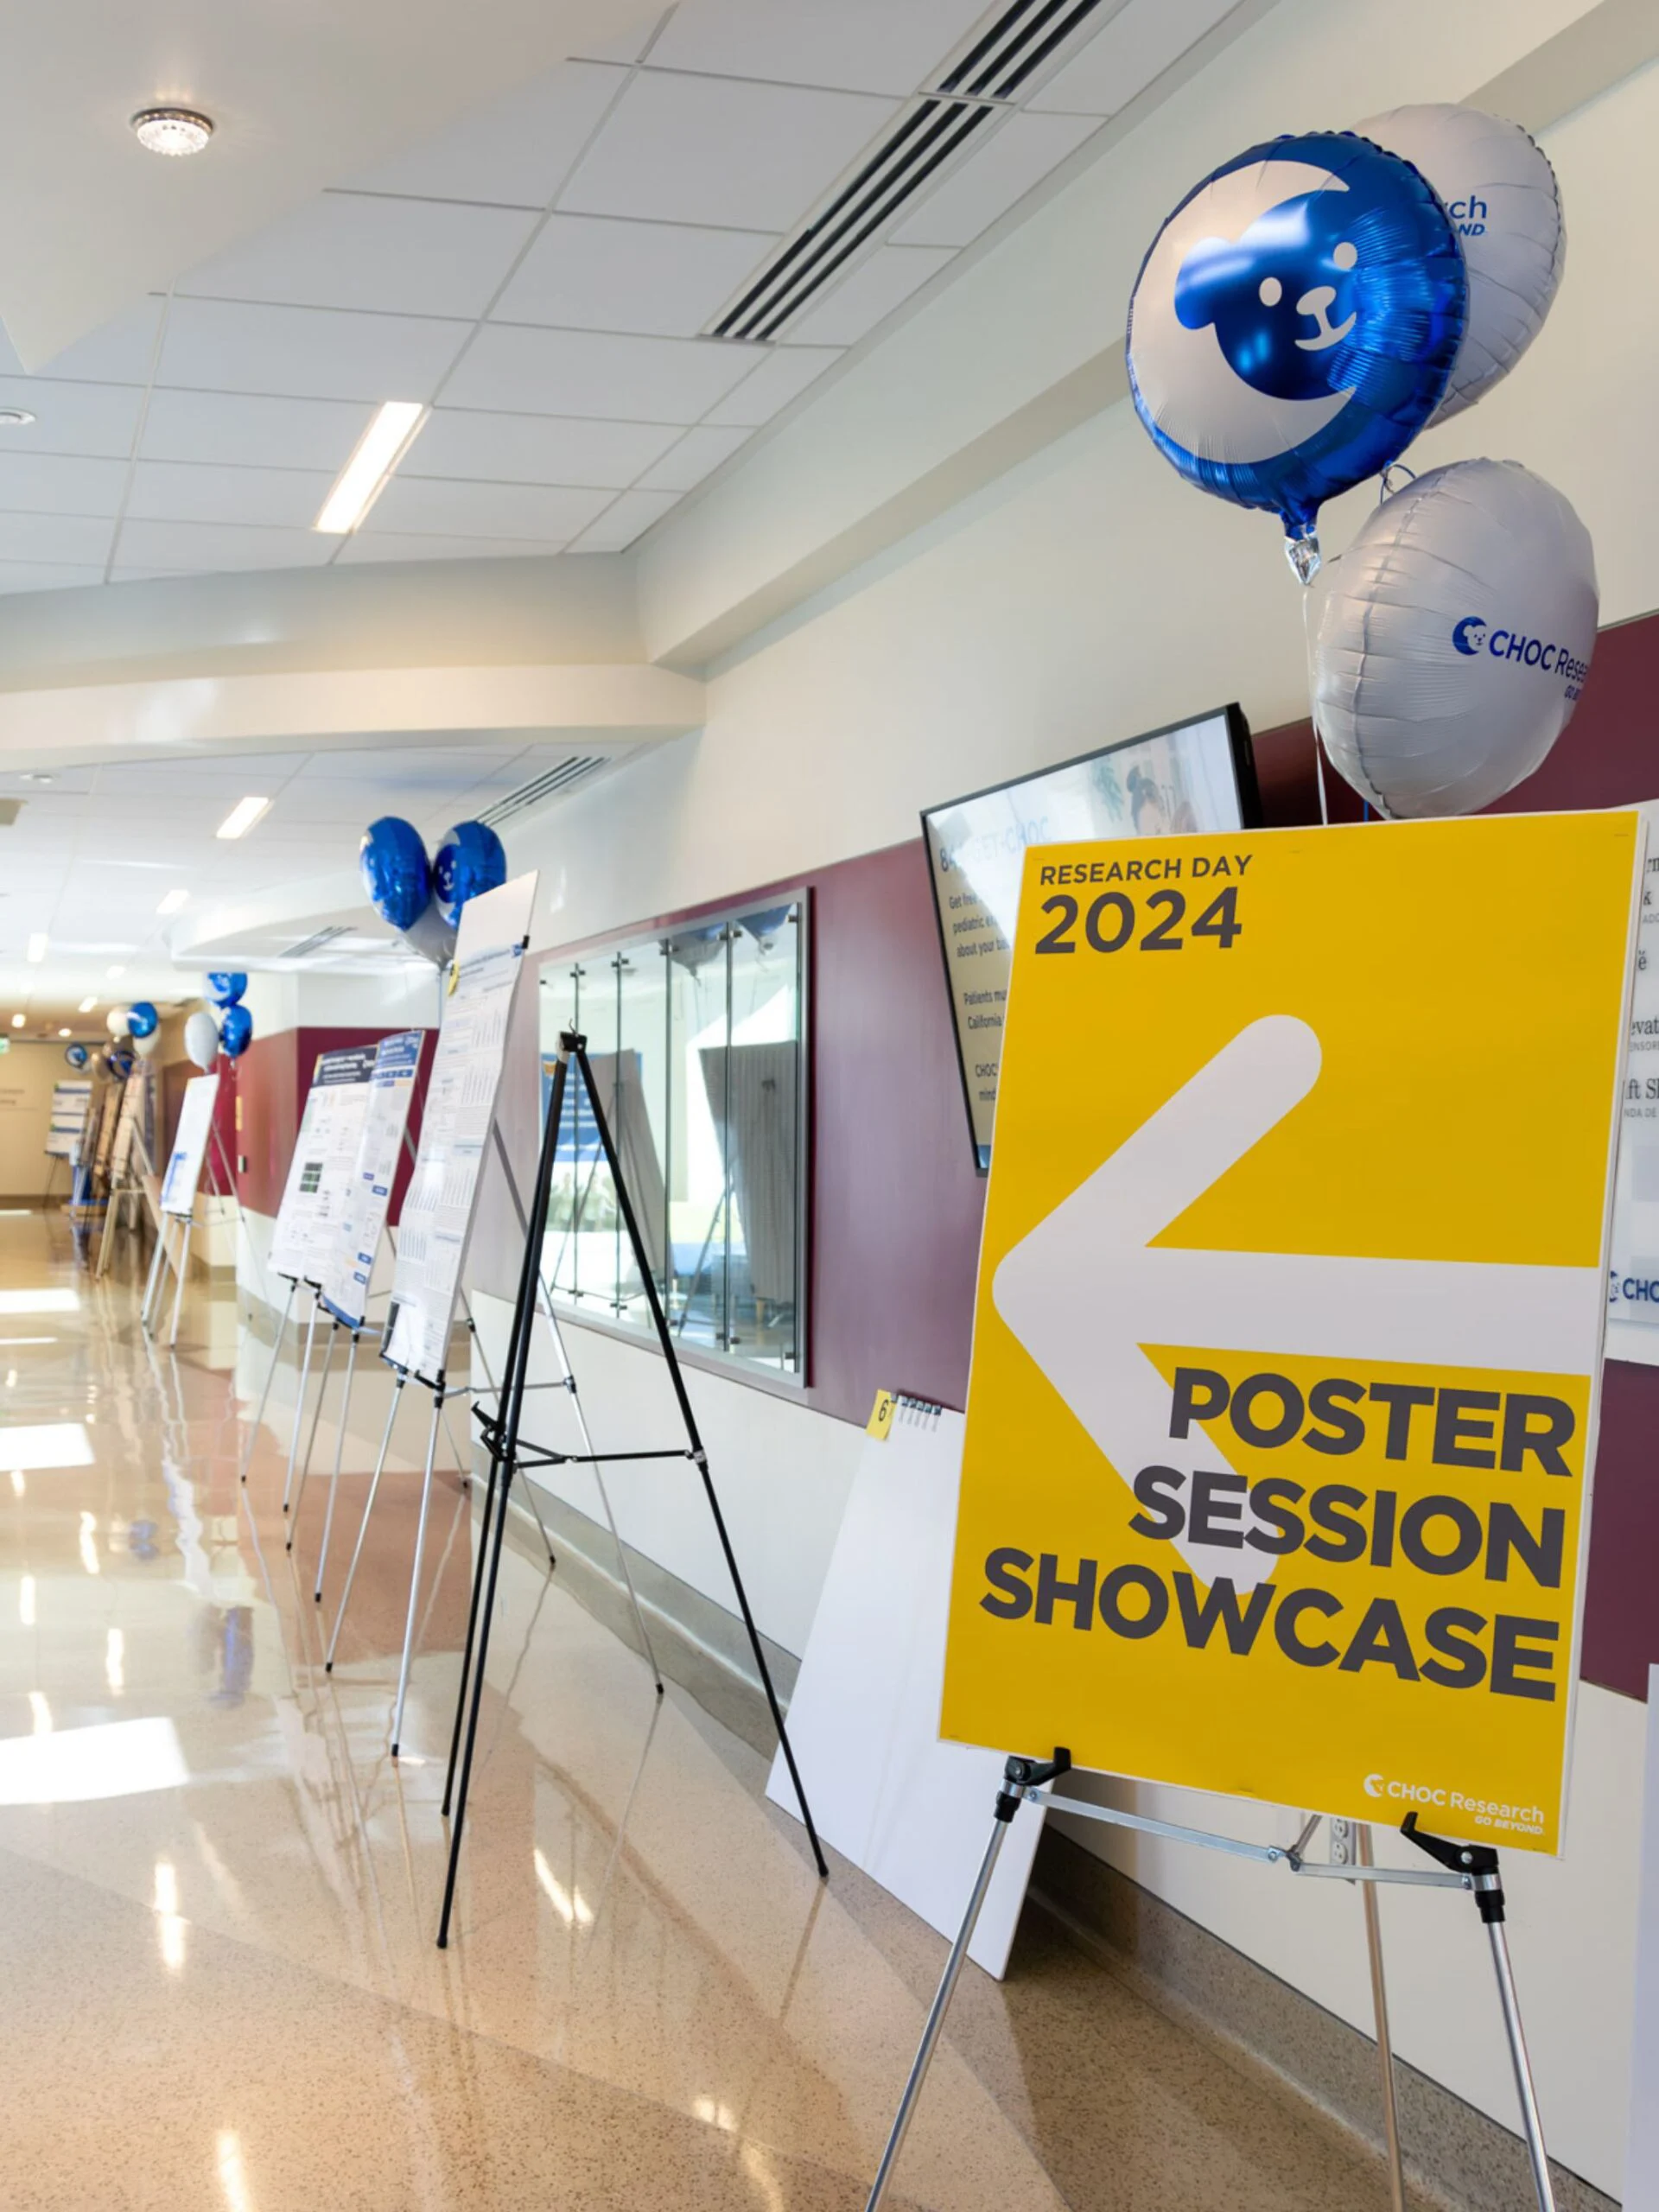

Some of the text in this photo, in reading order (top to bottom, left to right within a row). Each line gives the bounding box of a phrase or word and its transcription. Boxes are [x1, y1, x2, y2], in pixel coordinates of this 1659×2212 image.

[1489, 630, 1556, 671] CHOC
[1040, 855, 1253, 886] RESEARCH DAY
[1035, 887, 1243, 955] 2024
[963, 990, 993, 1006] Patients
[968, 1013, 1002, 1030] California
[878, 1398, 889, 1422] 6
[1168, 1367, 1576, 1477] POSTER
[1128, 1465, 1566, 1588] SESSION
[979, 1547, 1560, 1701] SHOWCASE
[1388, 1780, 1545, 1824] CHOC Research
[1474, 1815, 1492, 1826] GO
